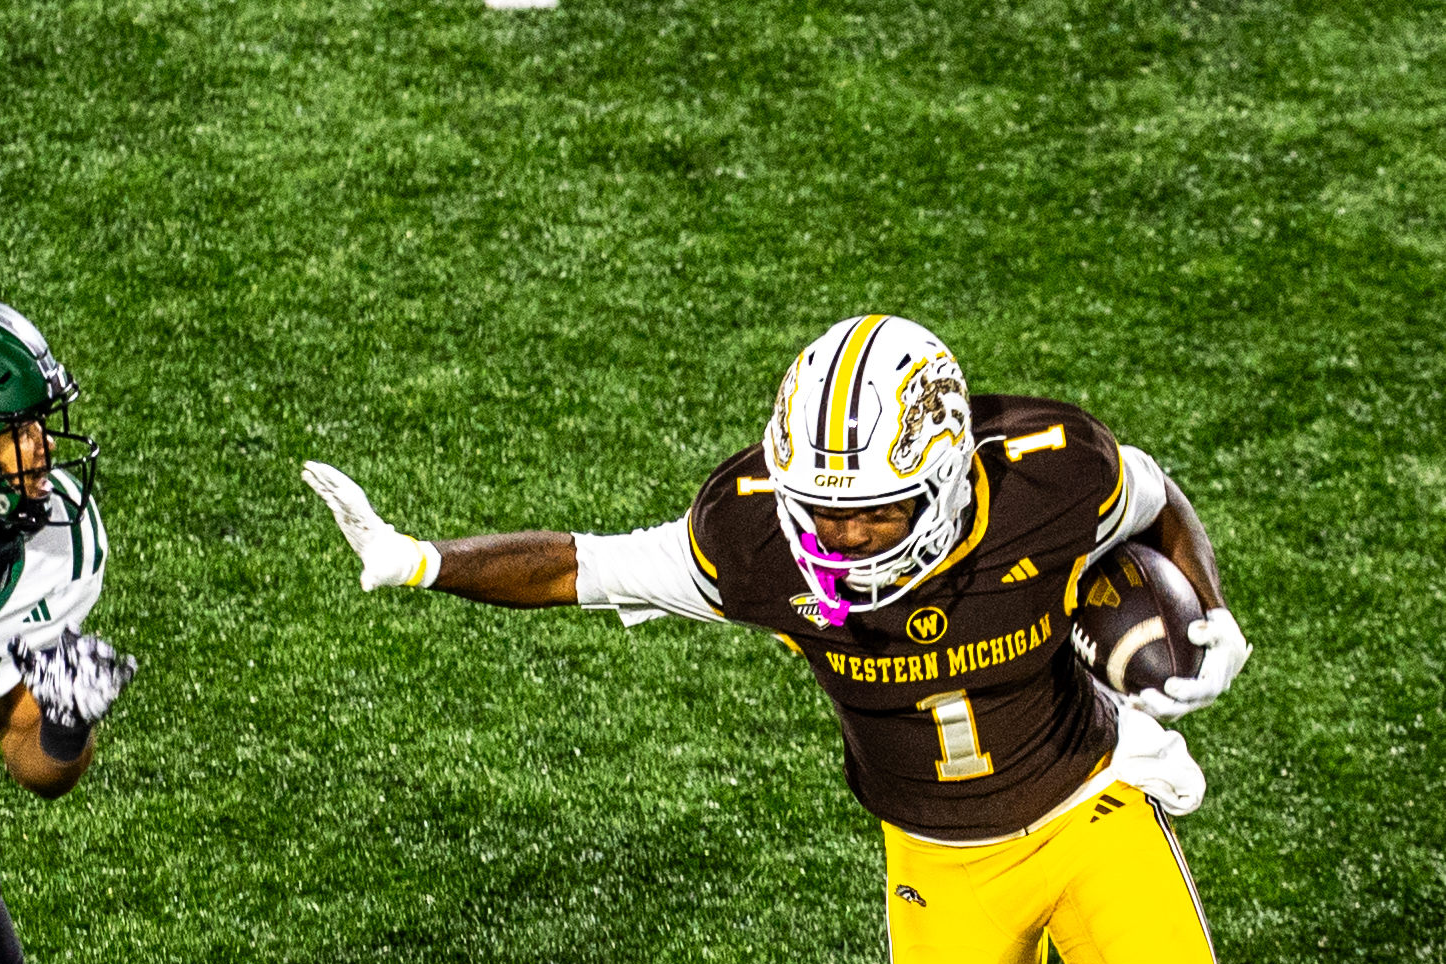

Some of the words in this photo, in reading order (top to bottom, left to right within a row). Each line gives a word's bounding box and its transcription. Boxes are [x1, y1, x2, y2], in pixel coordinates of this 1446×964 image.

[1005, 423, 1067, 463] 1
[814, 474, 856, 490] GRIT
[913, 613, 939, 640] W
[825, 651, 939, 683] WESTERN
[947, 612, 1052, 677] MICHIGAN
[915, 688, 995, 782] 1
